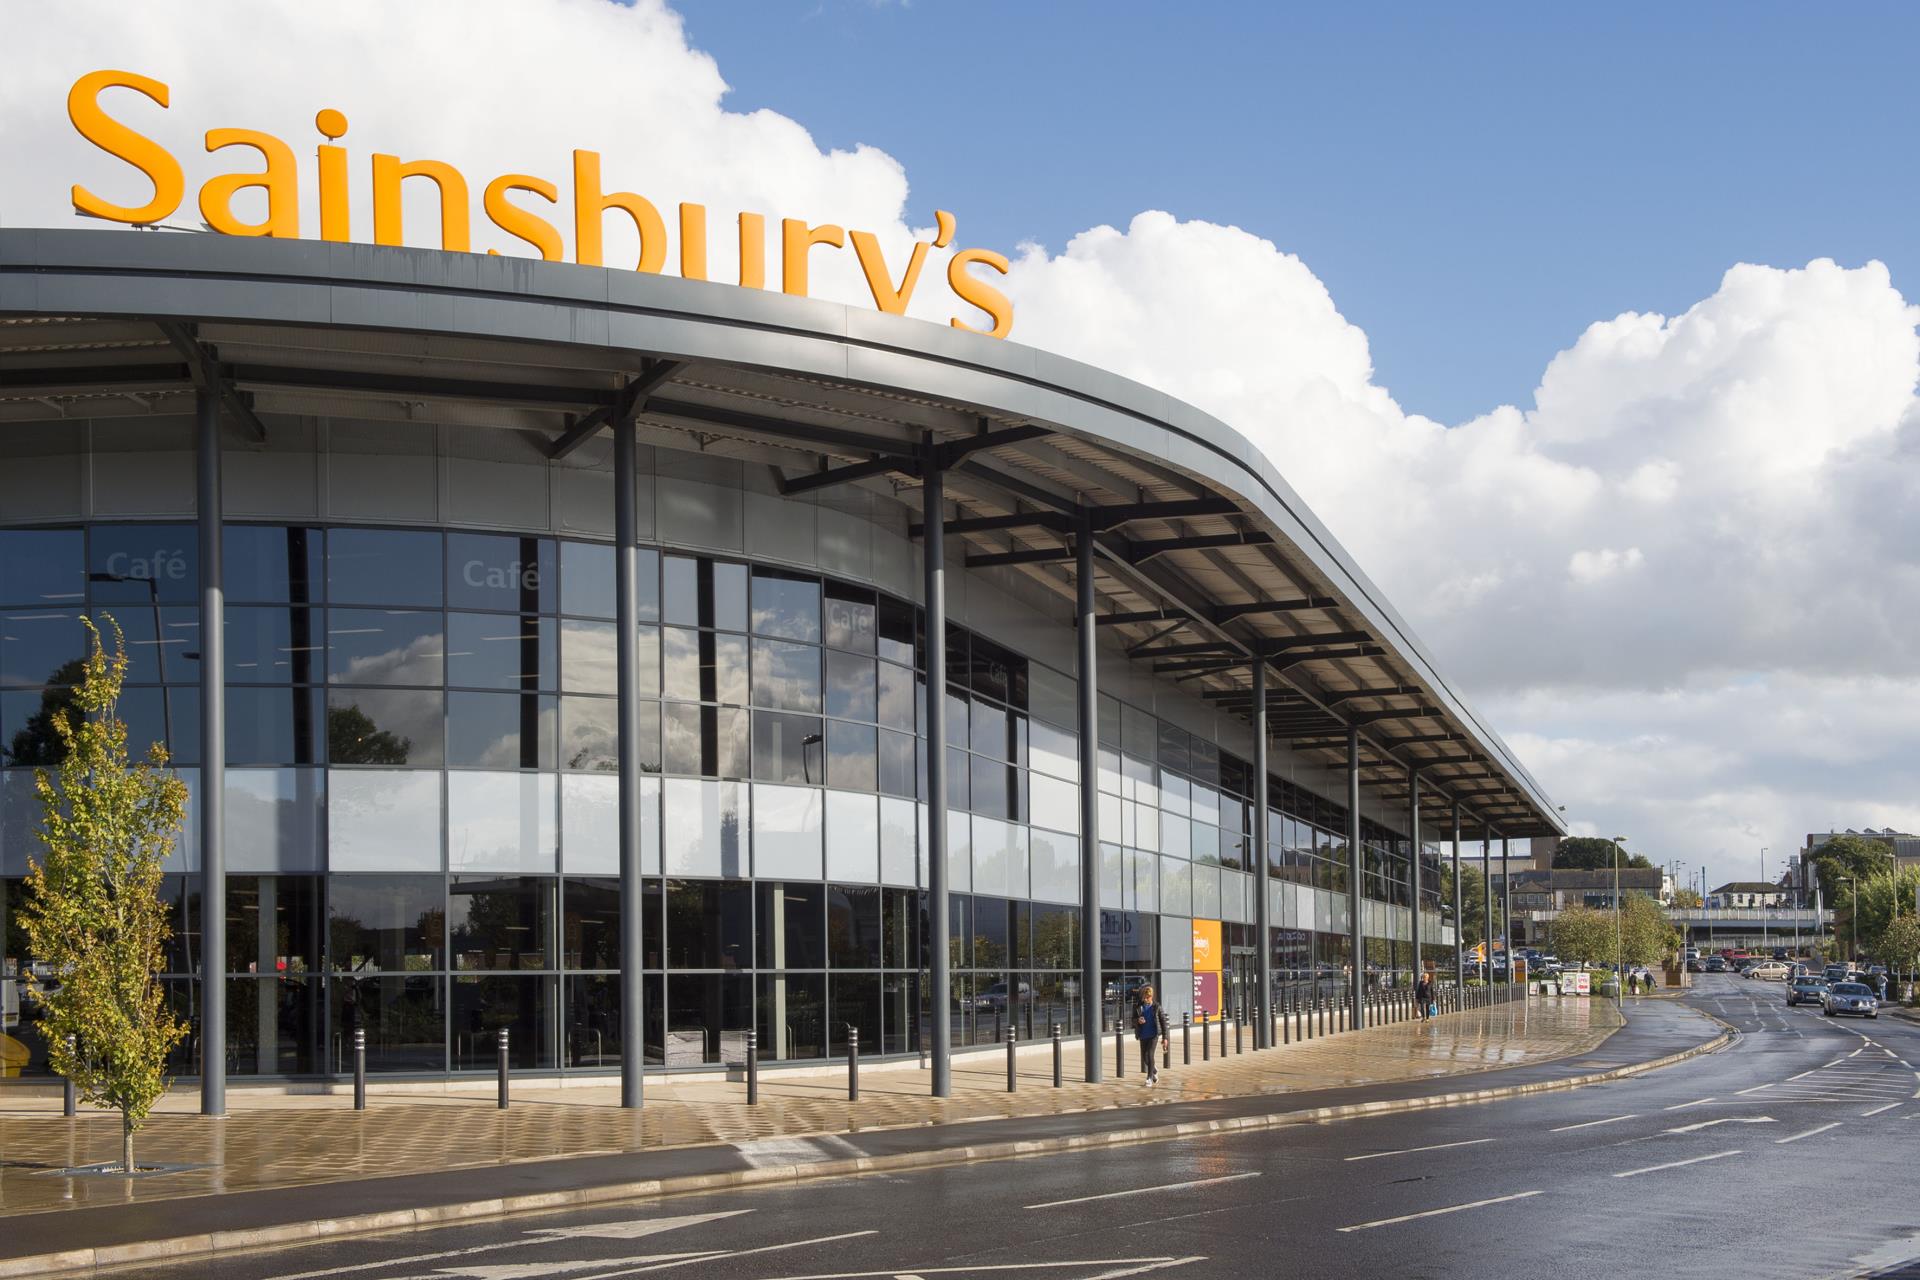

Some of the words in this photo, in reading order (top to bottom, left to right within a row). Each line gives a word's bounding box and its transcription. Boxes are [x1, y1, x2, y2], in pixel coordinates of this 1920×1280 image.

[68, 70, 1013, 339] Sainsbury's
[106, 549, 186, 580] Café
[463, 560, 541, 590] Café
